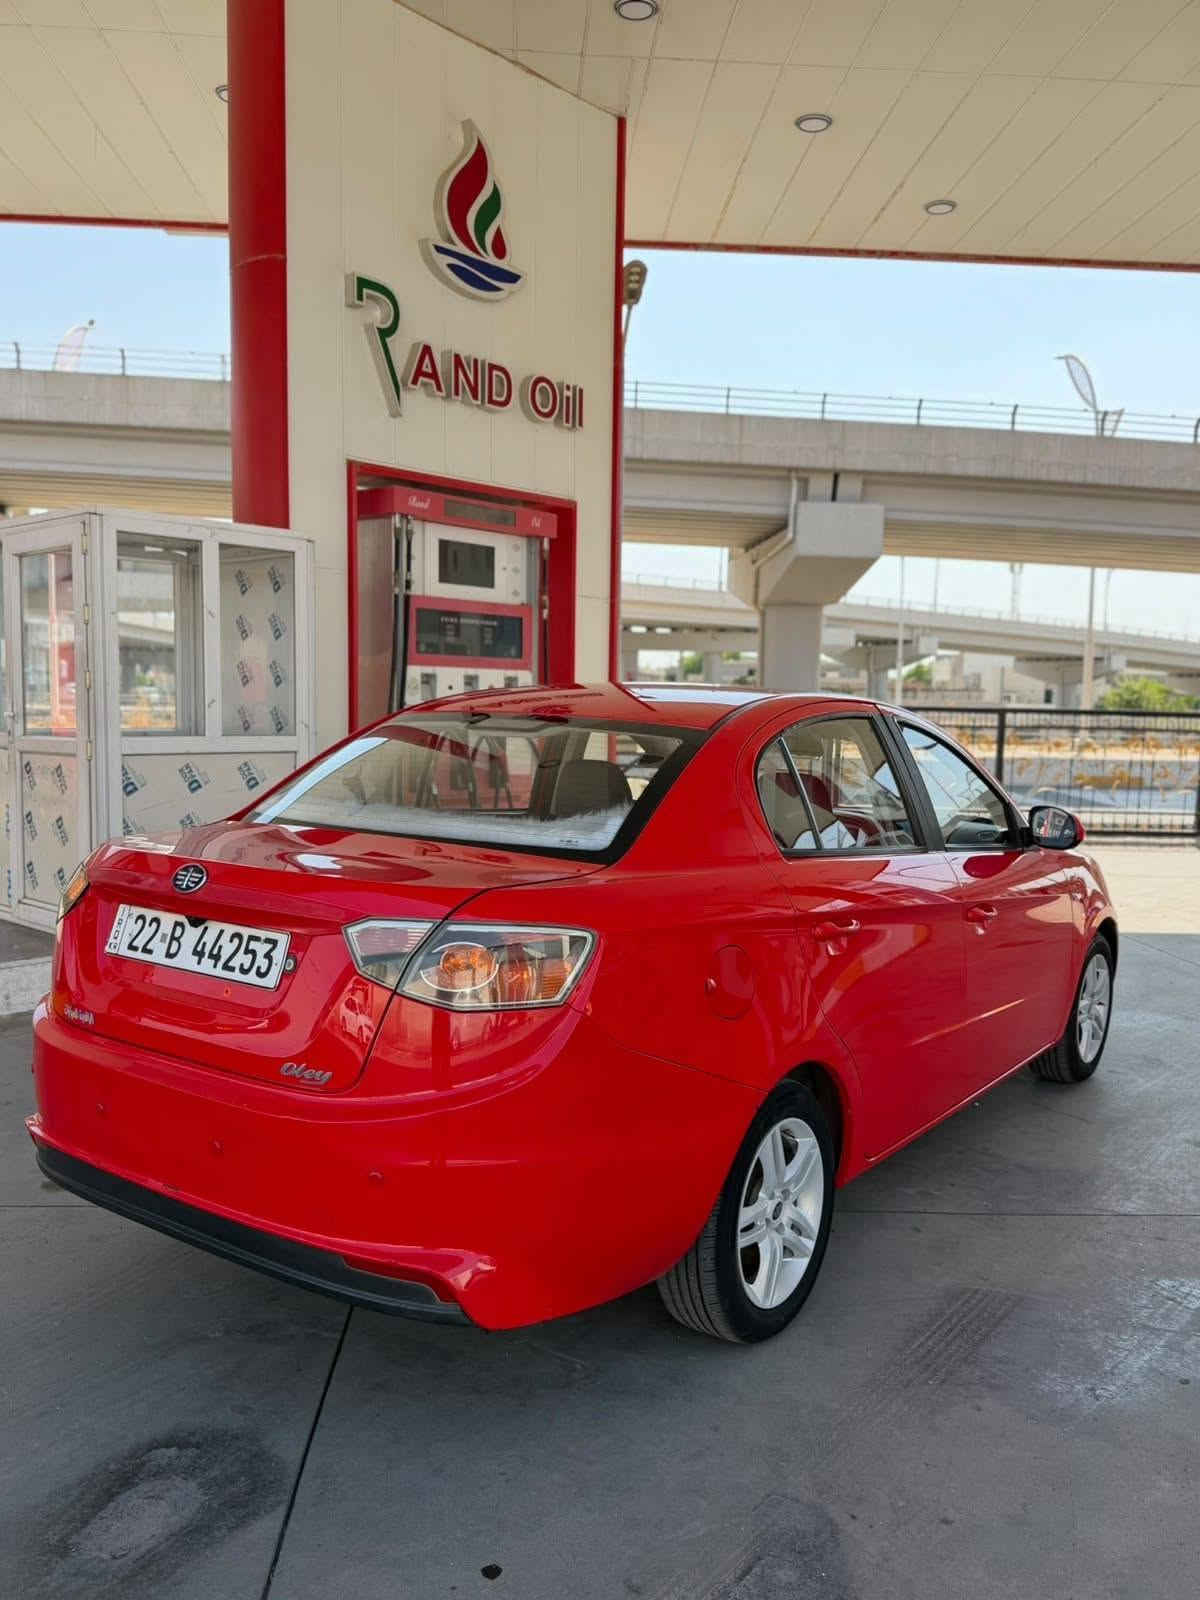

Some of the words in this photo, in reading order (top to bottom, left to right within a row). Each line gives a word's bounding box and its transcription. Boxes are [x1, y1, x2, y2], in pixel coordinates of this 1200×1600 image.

[346, 273, 513, 417] RAND
[523, 375, 584, 431] Oil
[127, 913, 162, 955] 22
[164, 920, 186, 960] B
[191, 924, 279, 979] 44253
